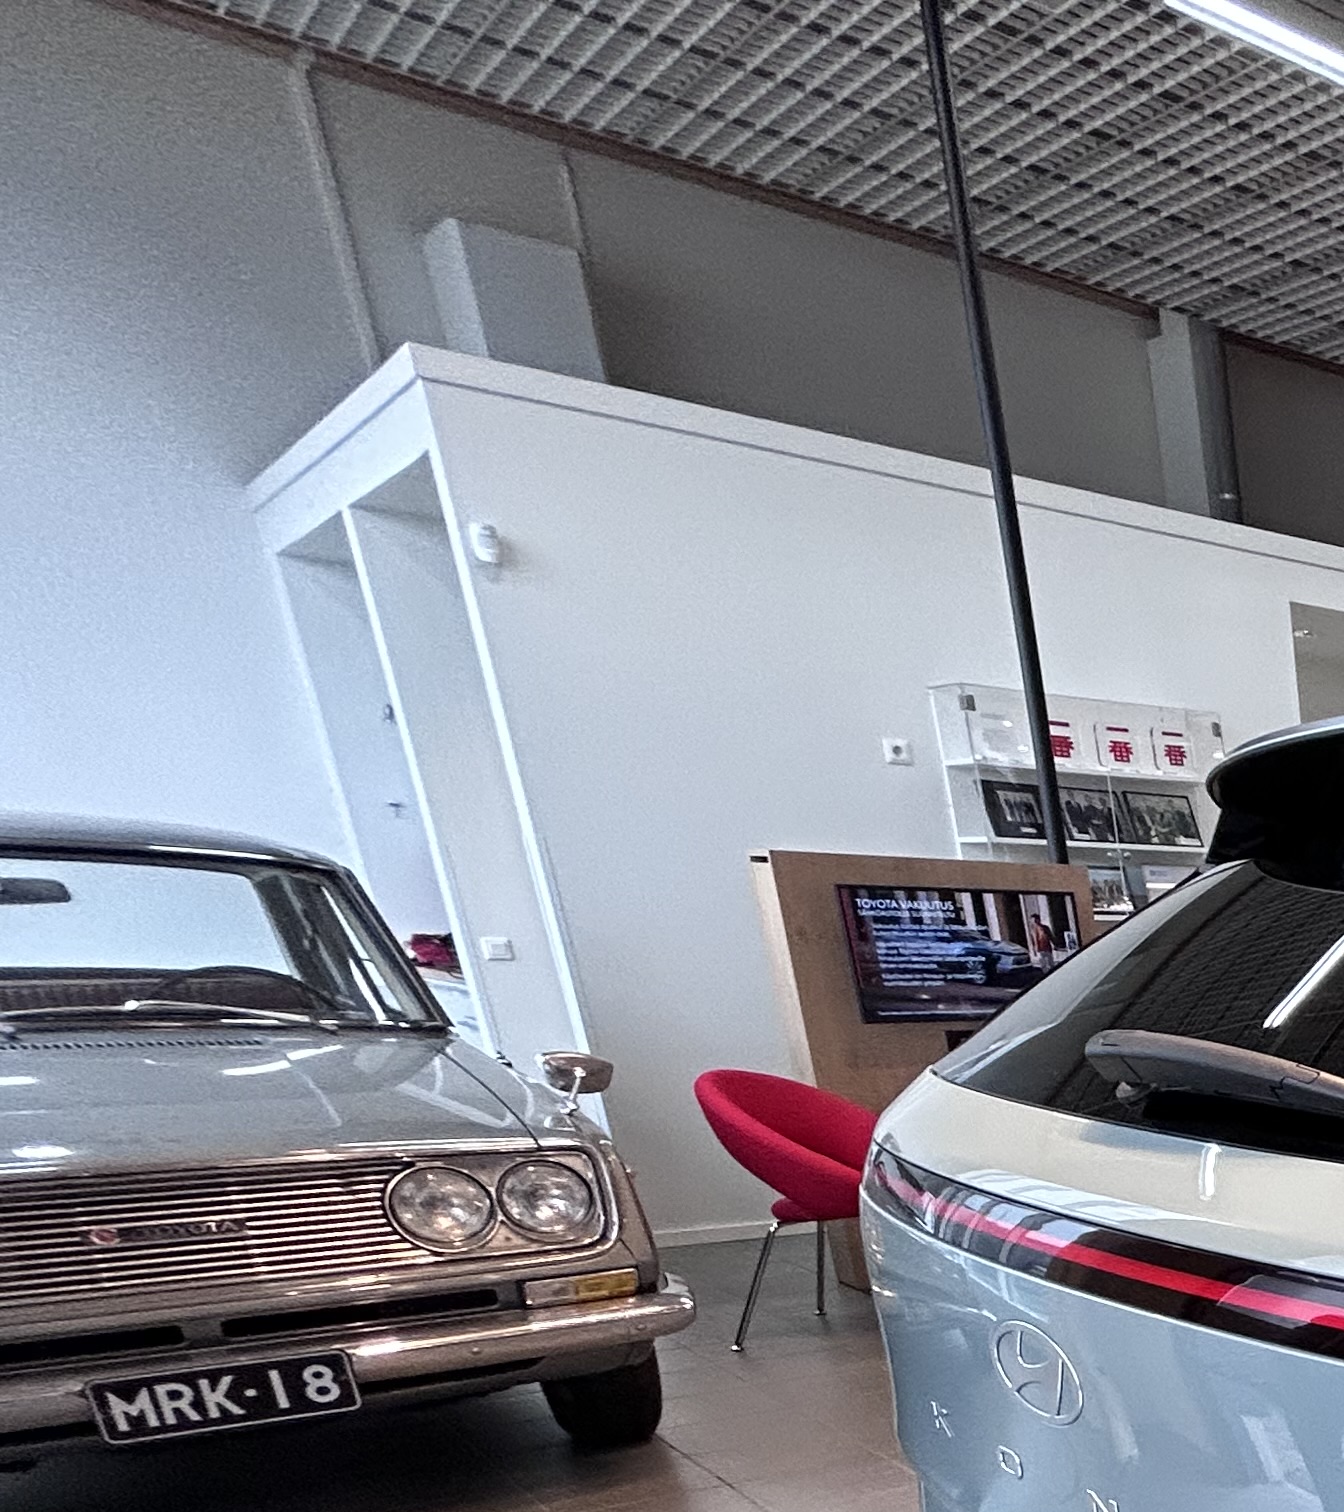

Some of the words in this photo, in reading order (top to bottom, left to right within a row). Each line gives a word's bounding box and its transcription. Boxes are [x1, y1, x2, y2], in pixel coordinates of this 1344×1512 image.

[855, 898, 898, 909] TOYOTA
[899, 900, 954, 911] VAKUUTUS
[104, 1364, 341, 1432] MRK-18
